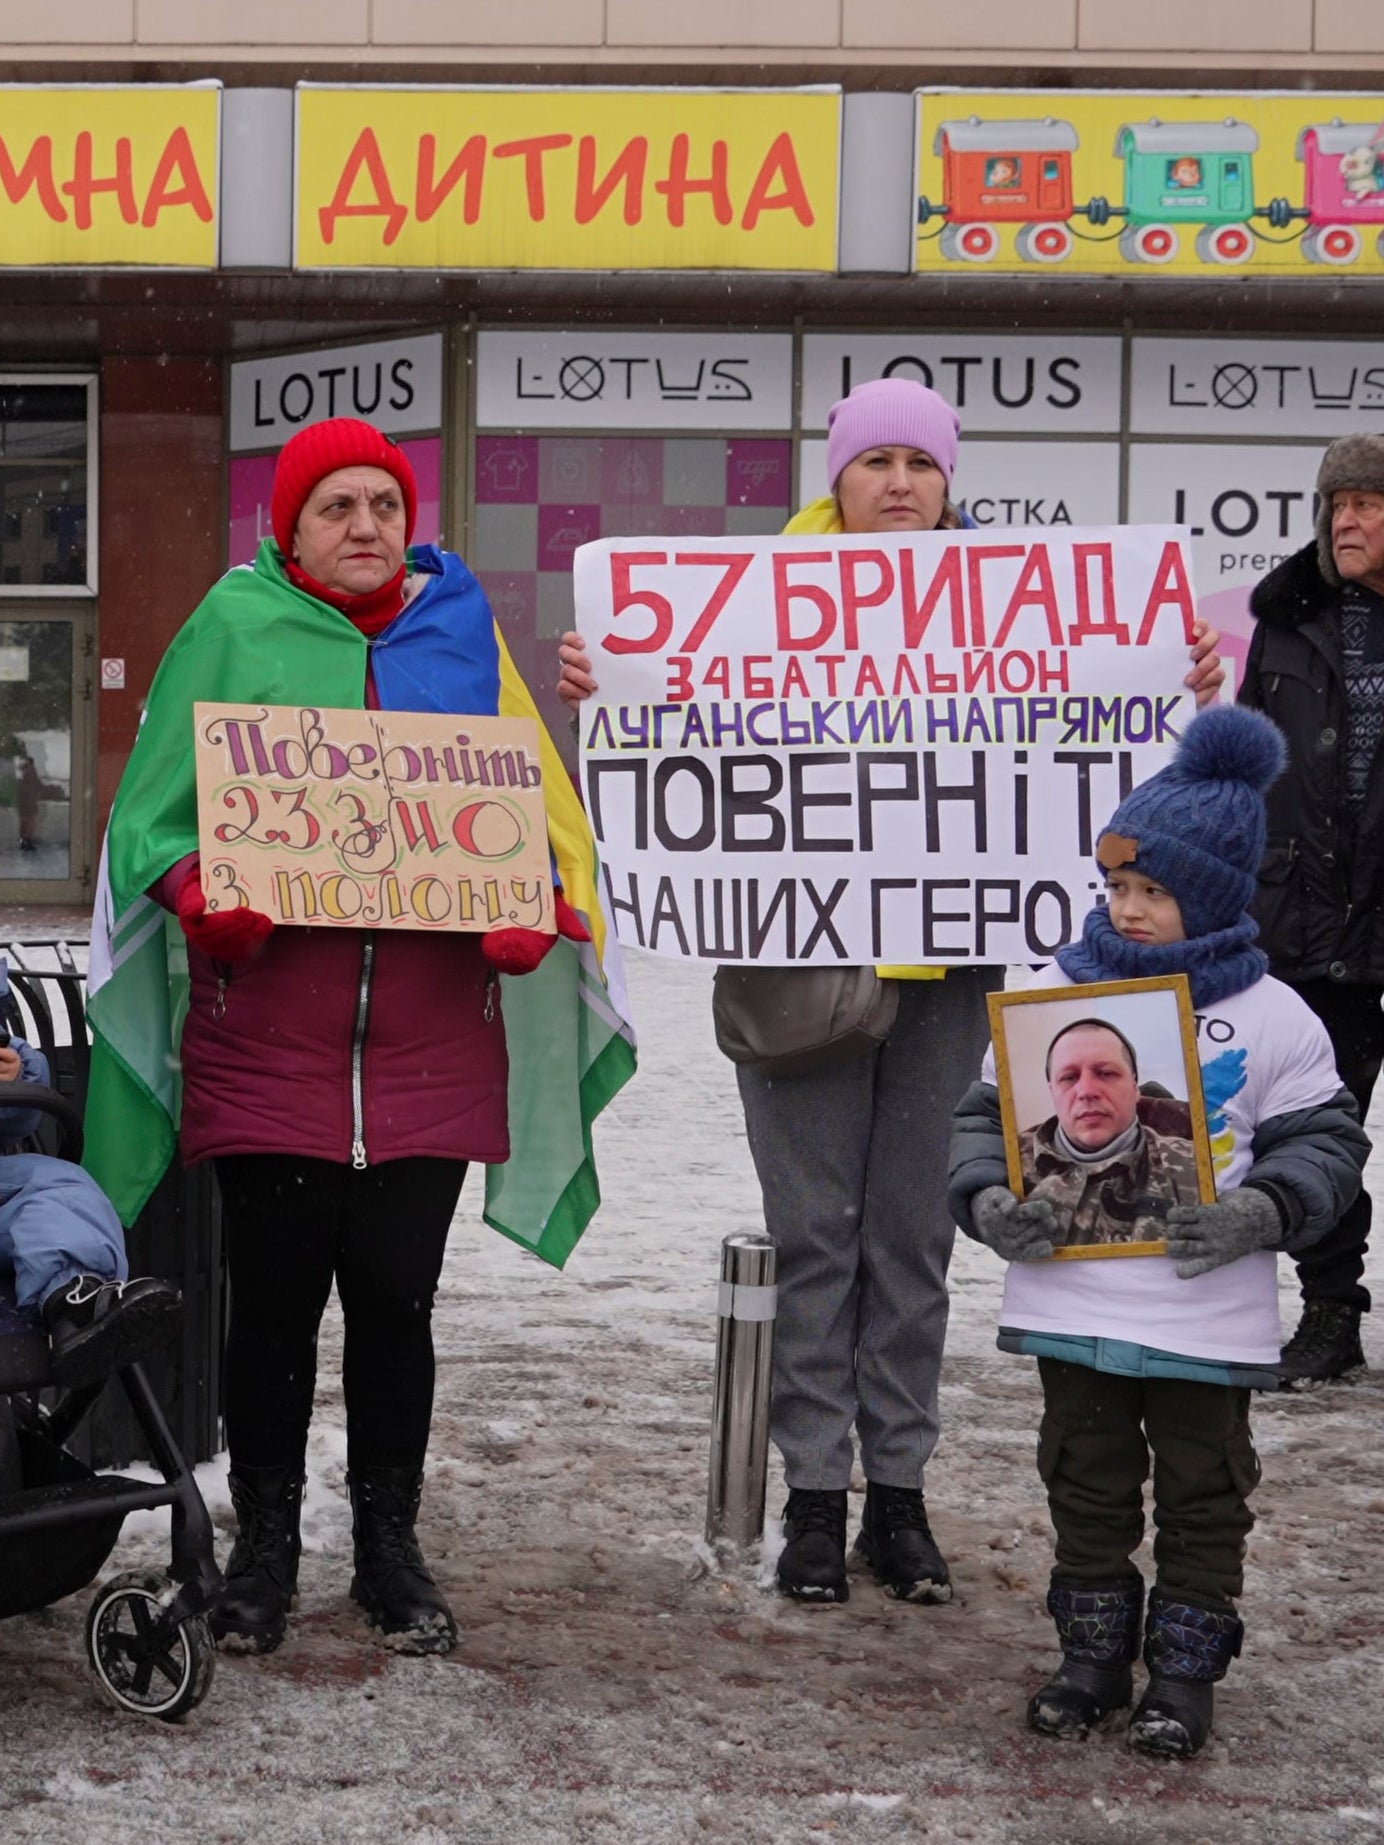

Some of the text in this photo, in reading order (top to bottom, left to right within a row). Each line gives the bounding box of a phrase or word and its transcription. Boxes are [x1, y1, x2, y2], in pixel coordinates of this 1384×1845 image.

[318, 126, 815, 246] ДИТИНА
[255, 358, 414, 427] LOTUS
[601, 541, 1199, 655] 57 БРИГАДА
[666, 649, 1070, 702] 34 БАТАЛЬЙОН
[206, 708, 542, 792] Поверніть
[926, 695, 1183, 744] НАПРЯМОК
[214, 786, 321, 850] 23
[601, 861, 851, 959] НАШИХ
